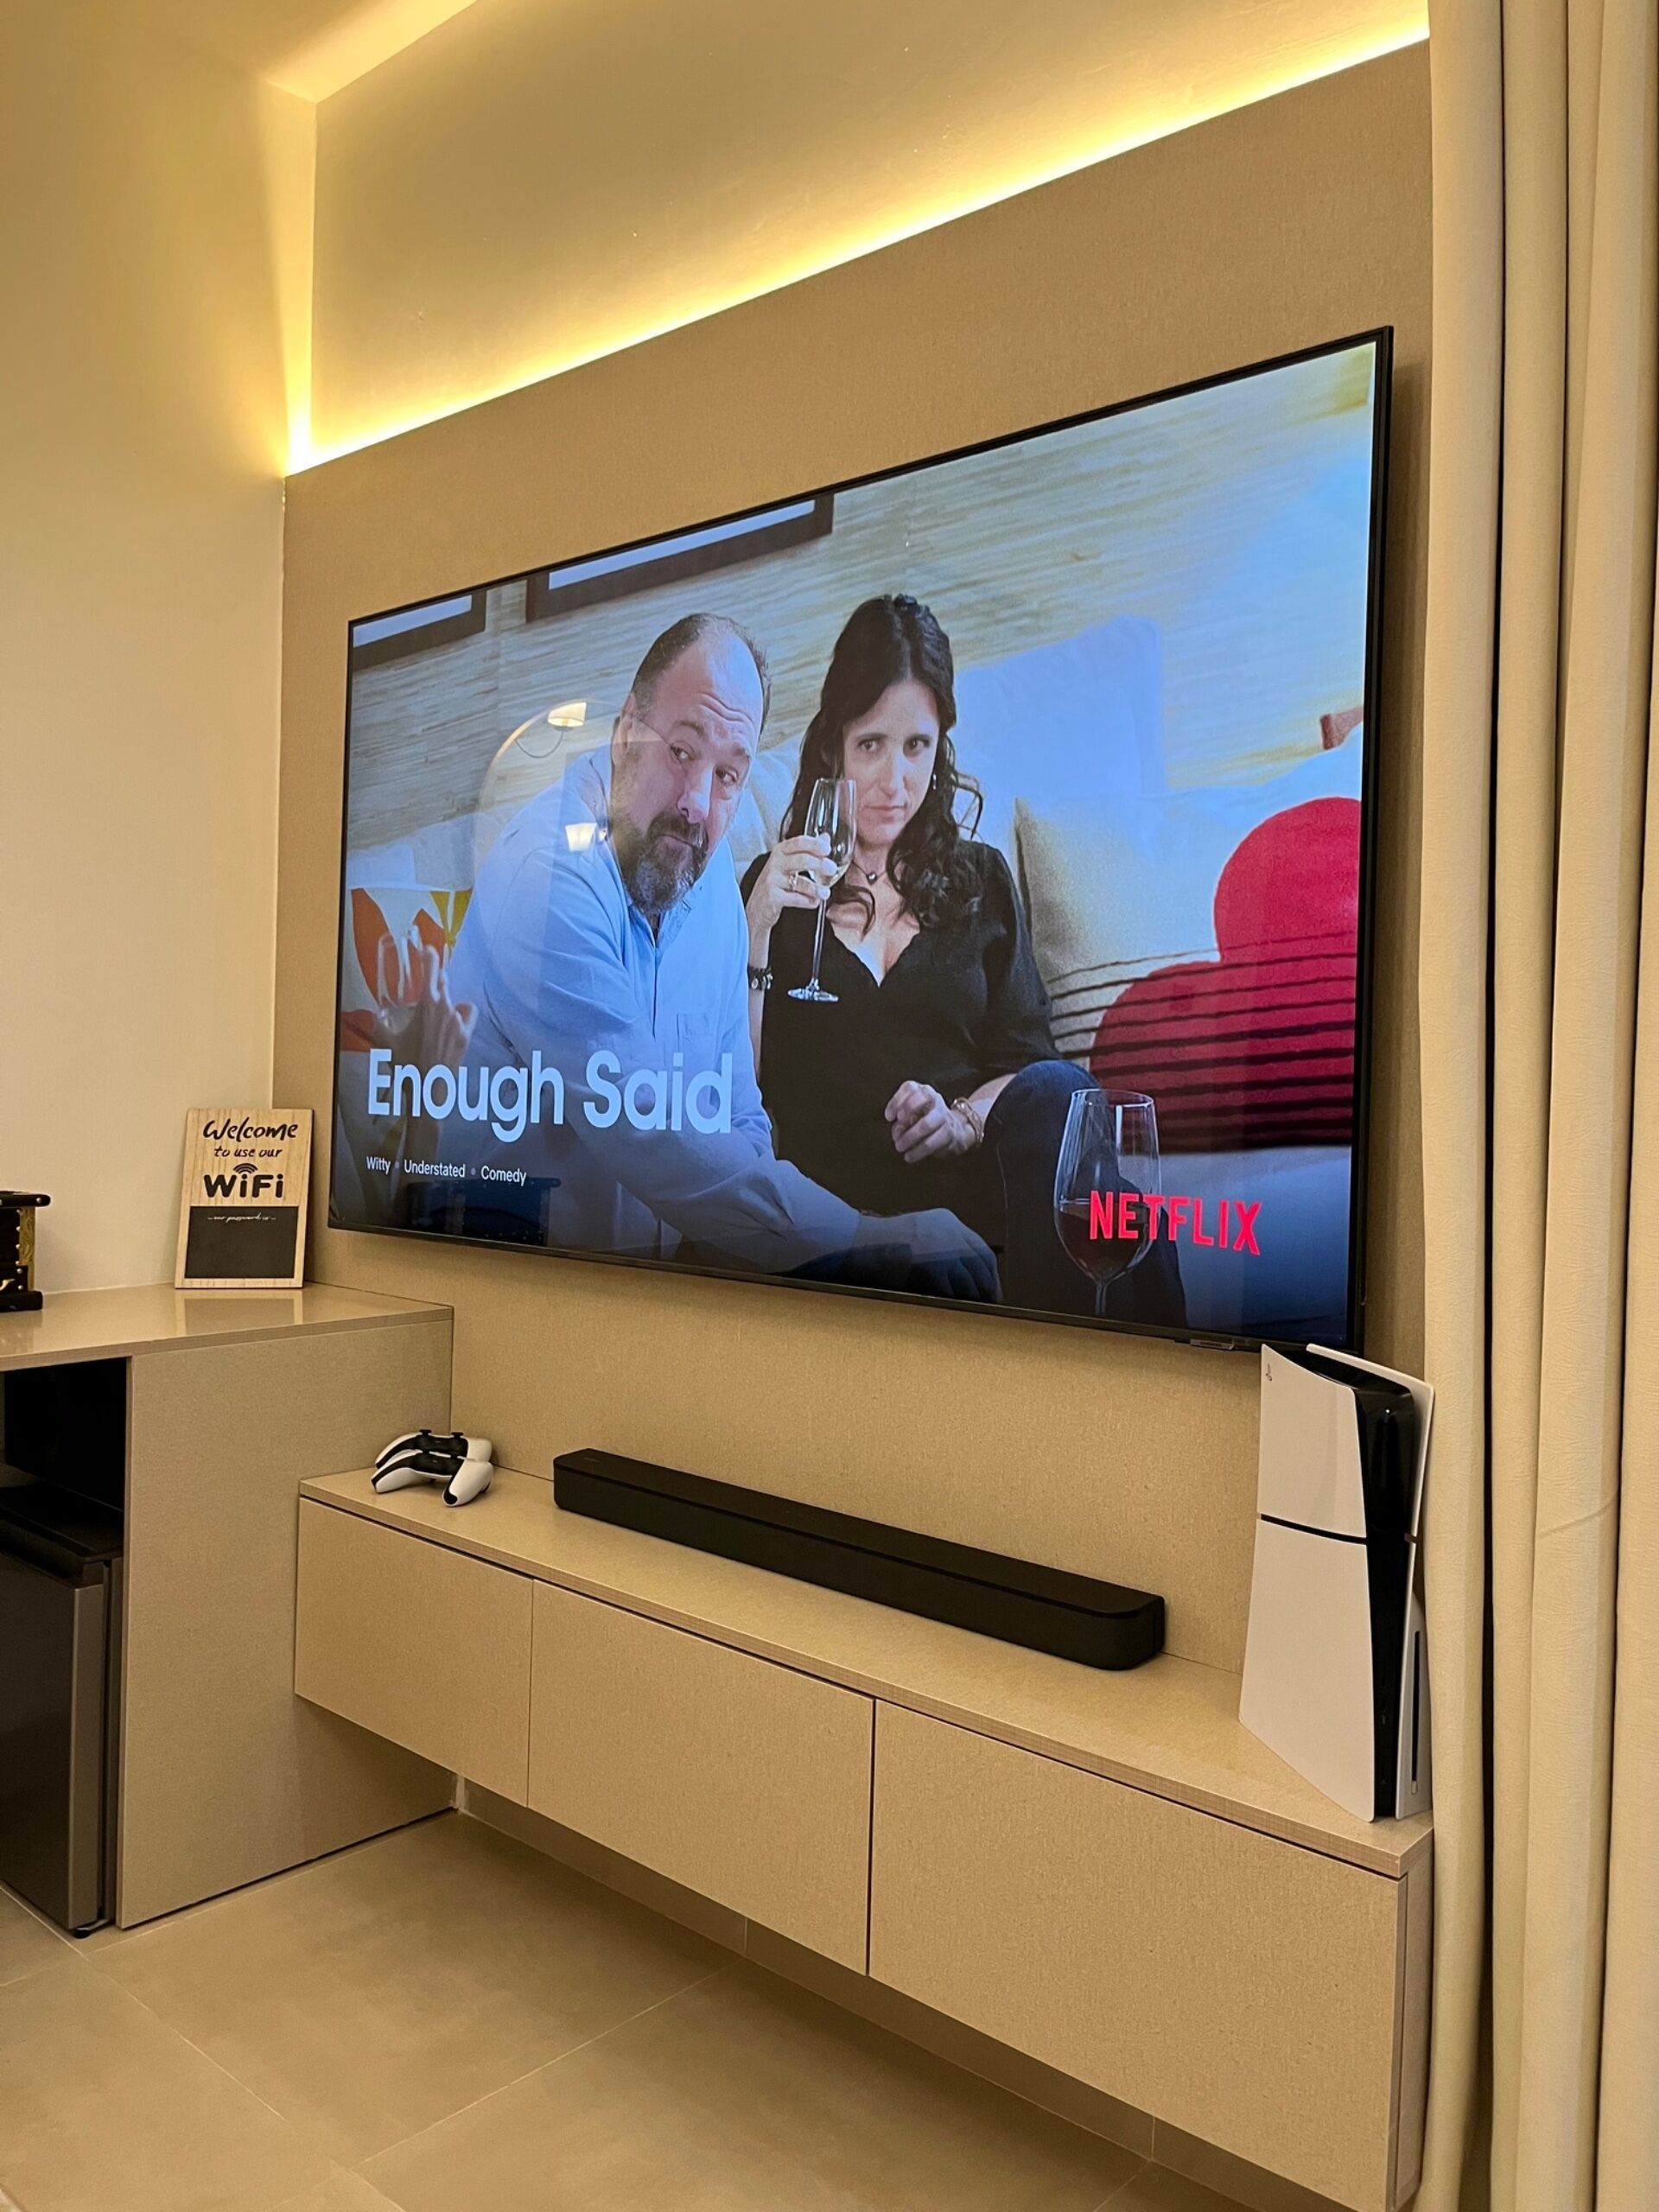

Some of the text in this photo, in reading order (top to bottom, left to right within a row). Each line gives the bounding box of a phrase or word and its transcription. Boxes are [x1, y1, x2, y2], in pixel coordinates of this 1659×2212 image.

[368, 1048, 733, 1143] Enough Said
[203, 1116, 298, 1142] Welcome
[214, 1146, 283, 1157] to use our
[366, 1156, 527, 1186] Witty Understated Comedy
[203, 1173, 283, 1198] WiFi
[1089, 1190, 1262, 1256] NETFLIX
